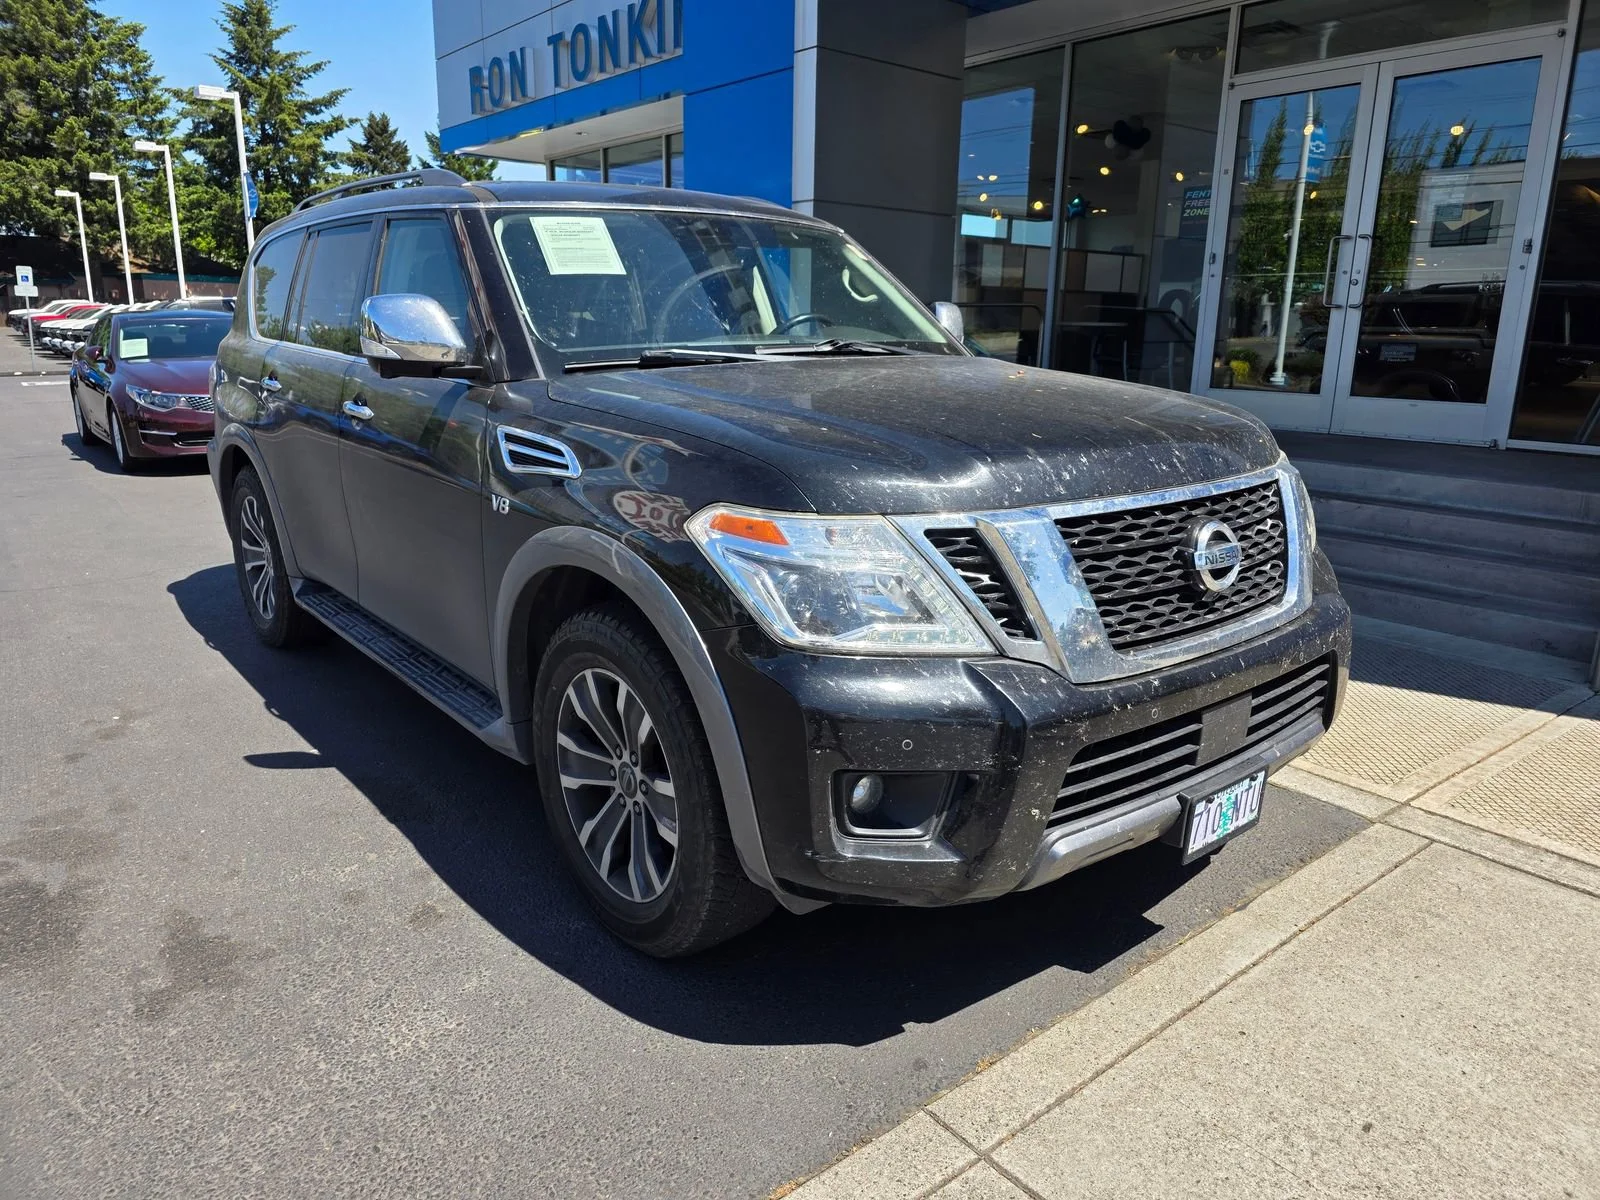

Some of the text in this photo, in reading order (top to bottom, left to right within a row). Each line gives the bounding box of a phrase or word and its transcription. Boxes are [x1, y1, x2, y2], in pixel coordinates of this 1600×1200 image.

[469, 47, 529, 115] RON
[1184, 199, 1210, 208] FREE
[1183, 208, 1210, 217] ZONE
[491, 494, 510, 514] V8
